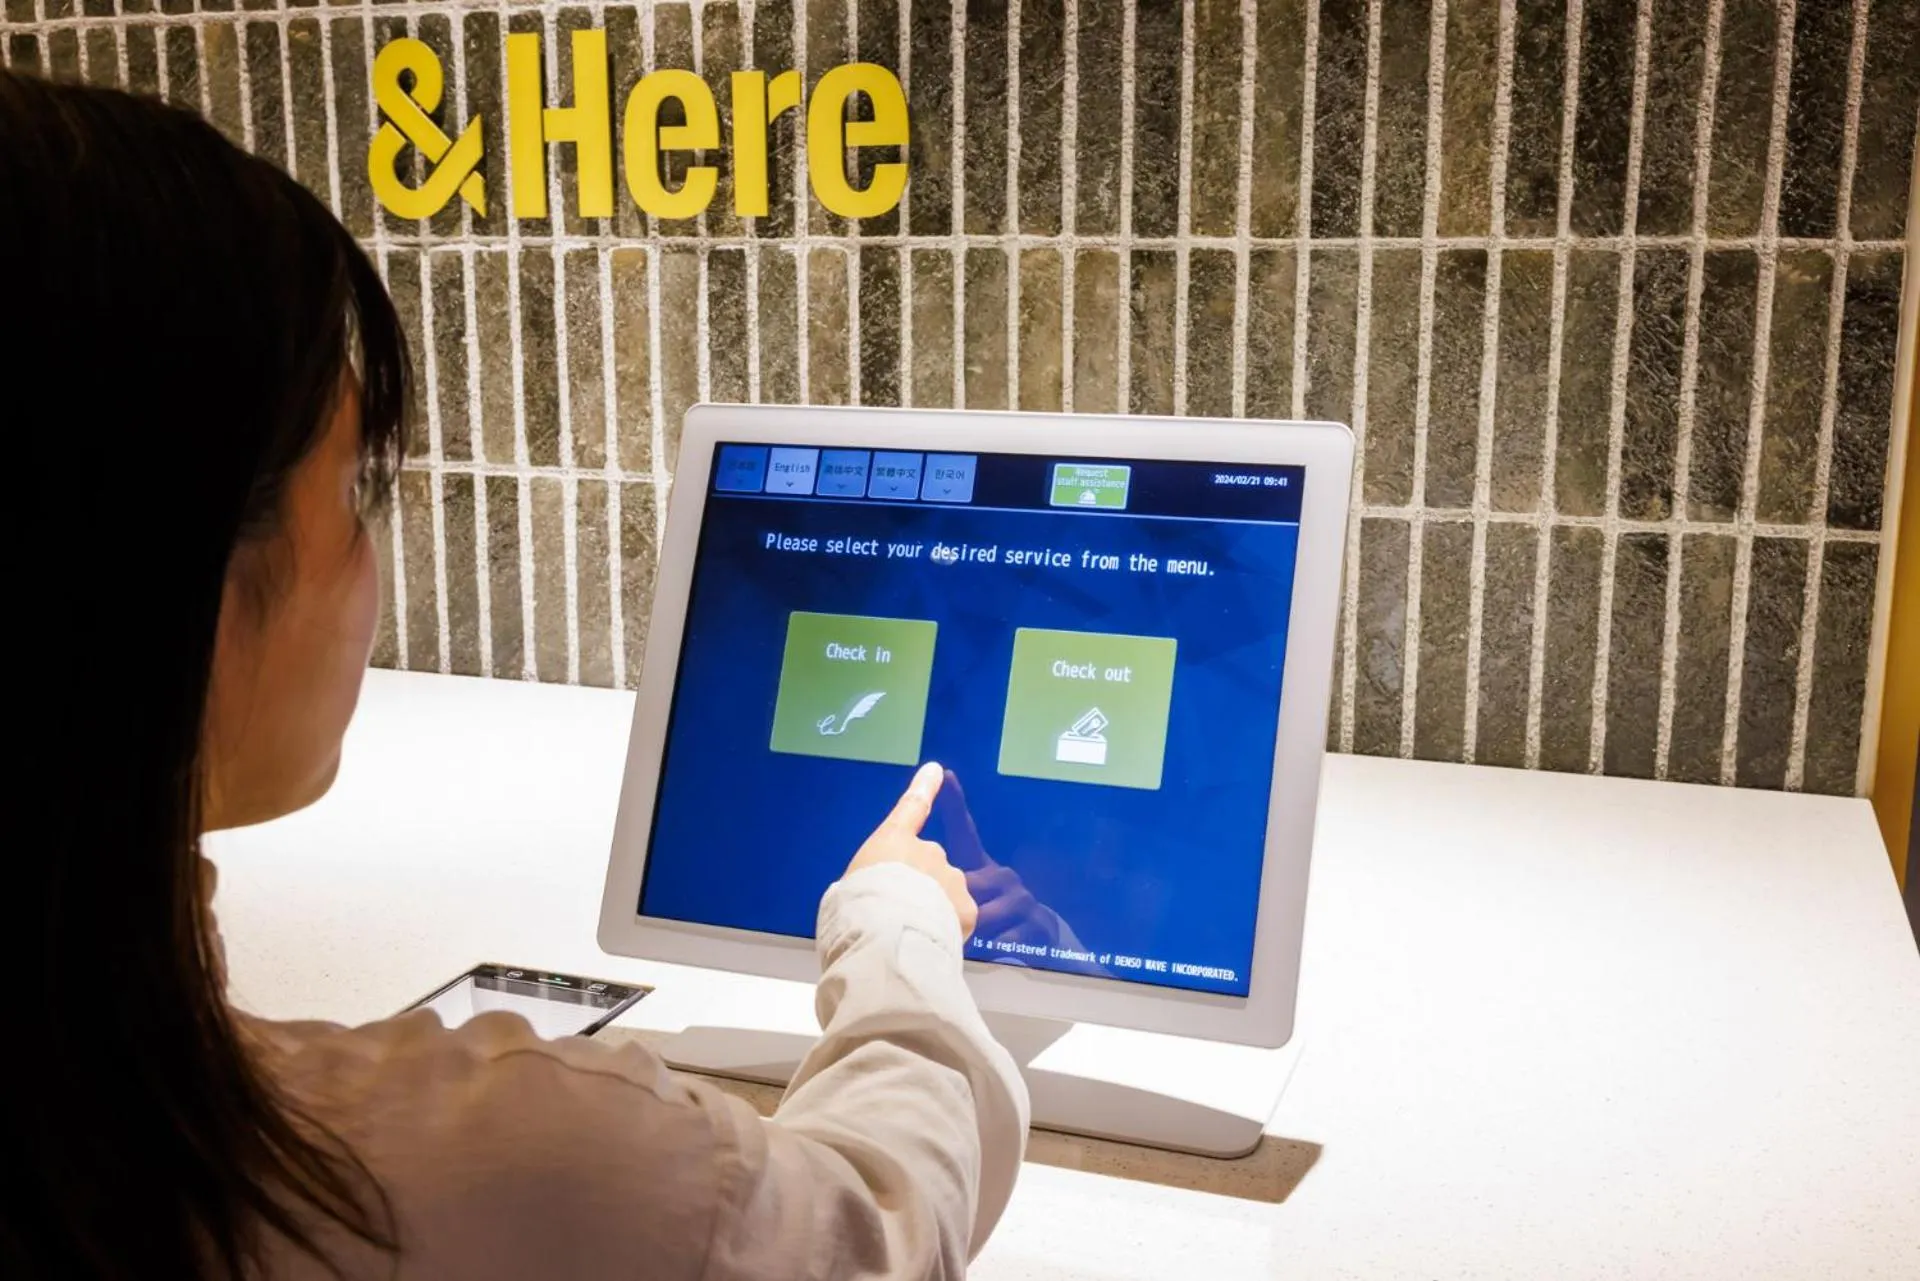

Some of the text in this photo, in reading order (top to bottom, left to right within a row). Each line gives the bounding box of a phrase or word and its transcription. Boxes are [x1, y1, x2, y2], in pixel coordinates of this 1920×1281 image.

[775, 462, 811, 473] English
[935, 469, 965, 480] 한국어
[1215, 474, 1288, 486] 2024/02/21 09:41
[765, 533, 1216, 576] Please select your desired service from the menu.
[826, 643, 891, 663] Check in
[1052, 660, 1132, 683] Check out
[973, 936, 1239, 982] is a registered trademark of DENSO WAVE INCORPORATED.
